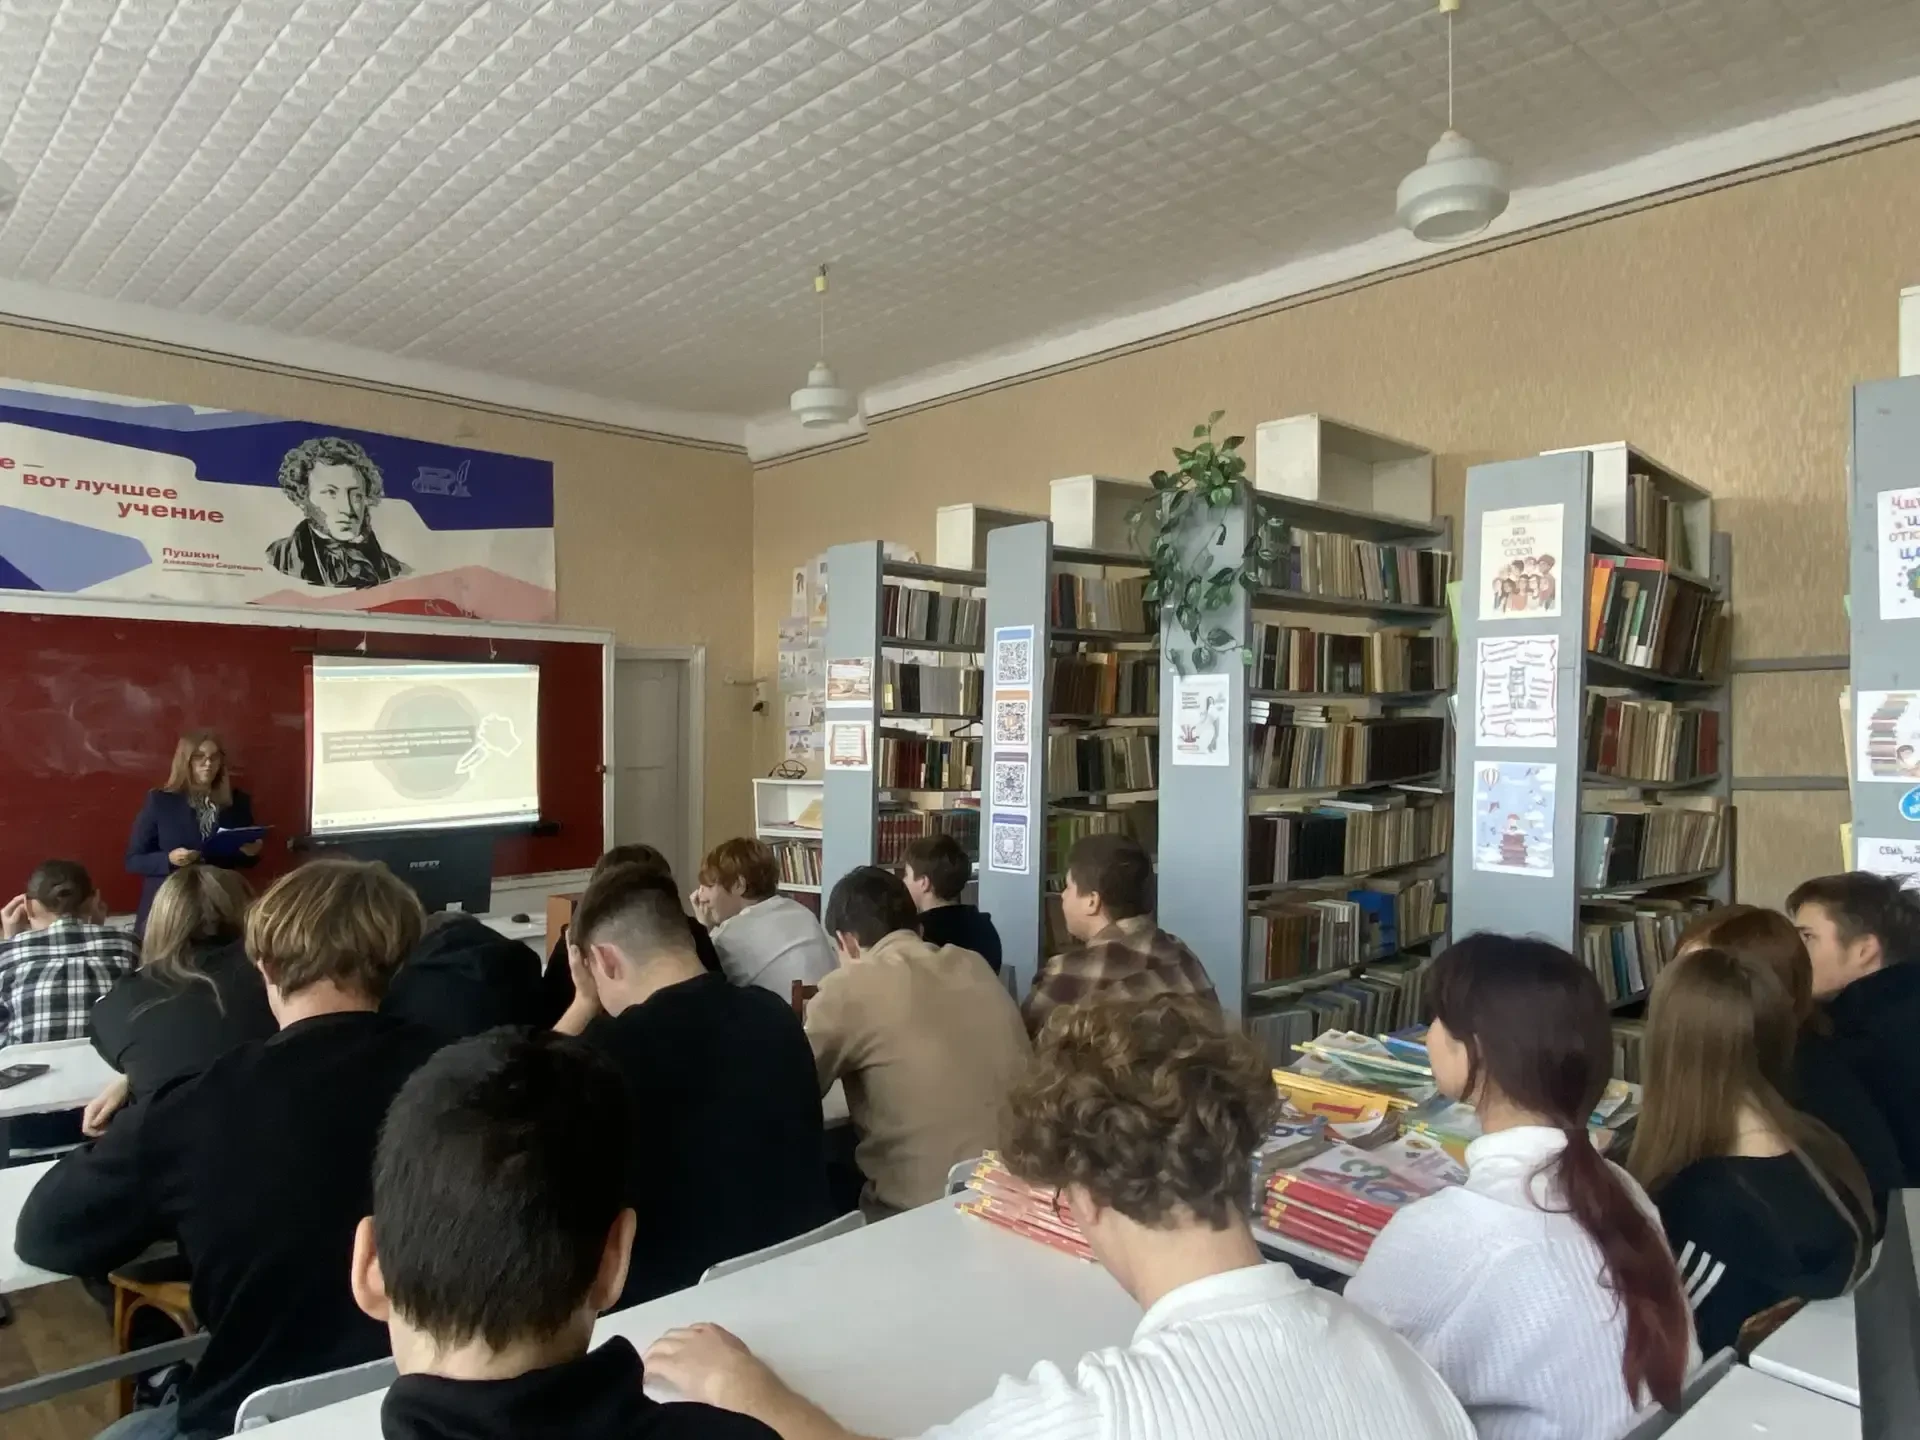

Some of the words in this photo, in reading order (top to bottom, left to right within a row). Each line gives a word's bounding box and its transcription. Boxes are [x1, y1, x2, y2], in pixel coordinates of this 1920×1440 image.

[22, 473, 70, 489] вот
[74, 479, 178, 499] лучшее
[117, 501, 225, 523] учение
[162, 547, 220, 560] Пушкин
